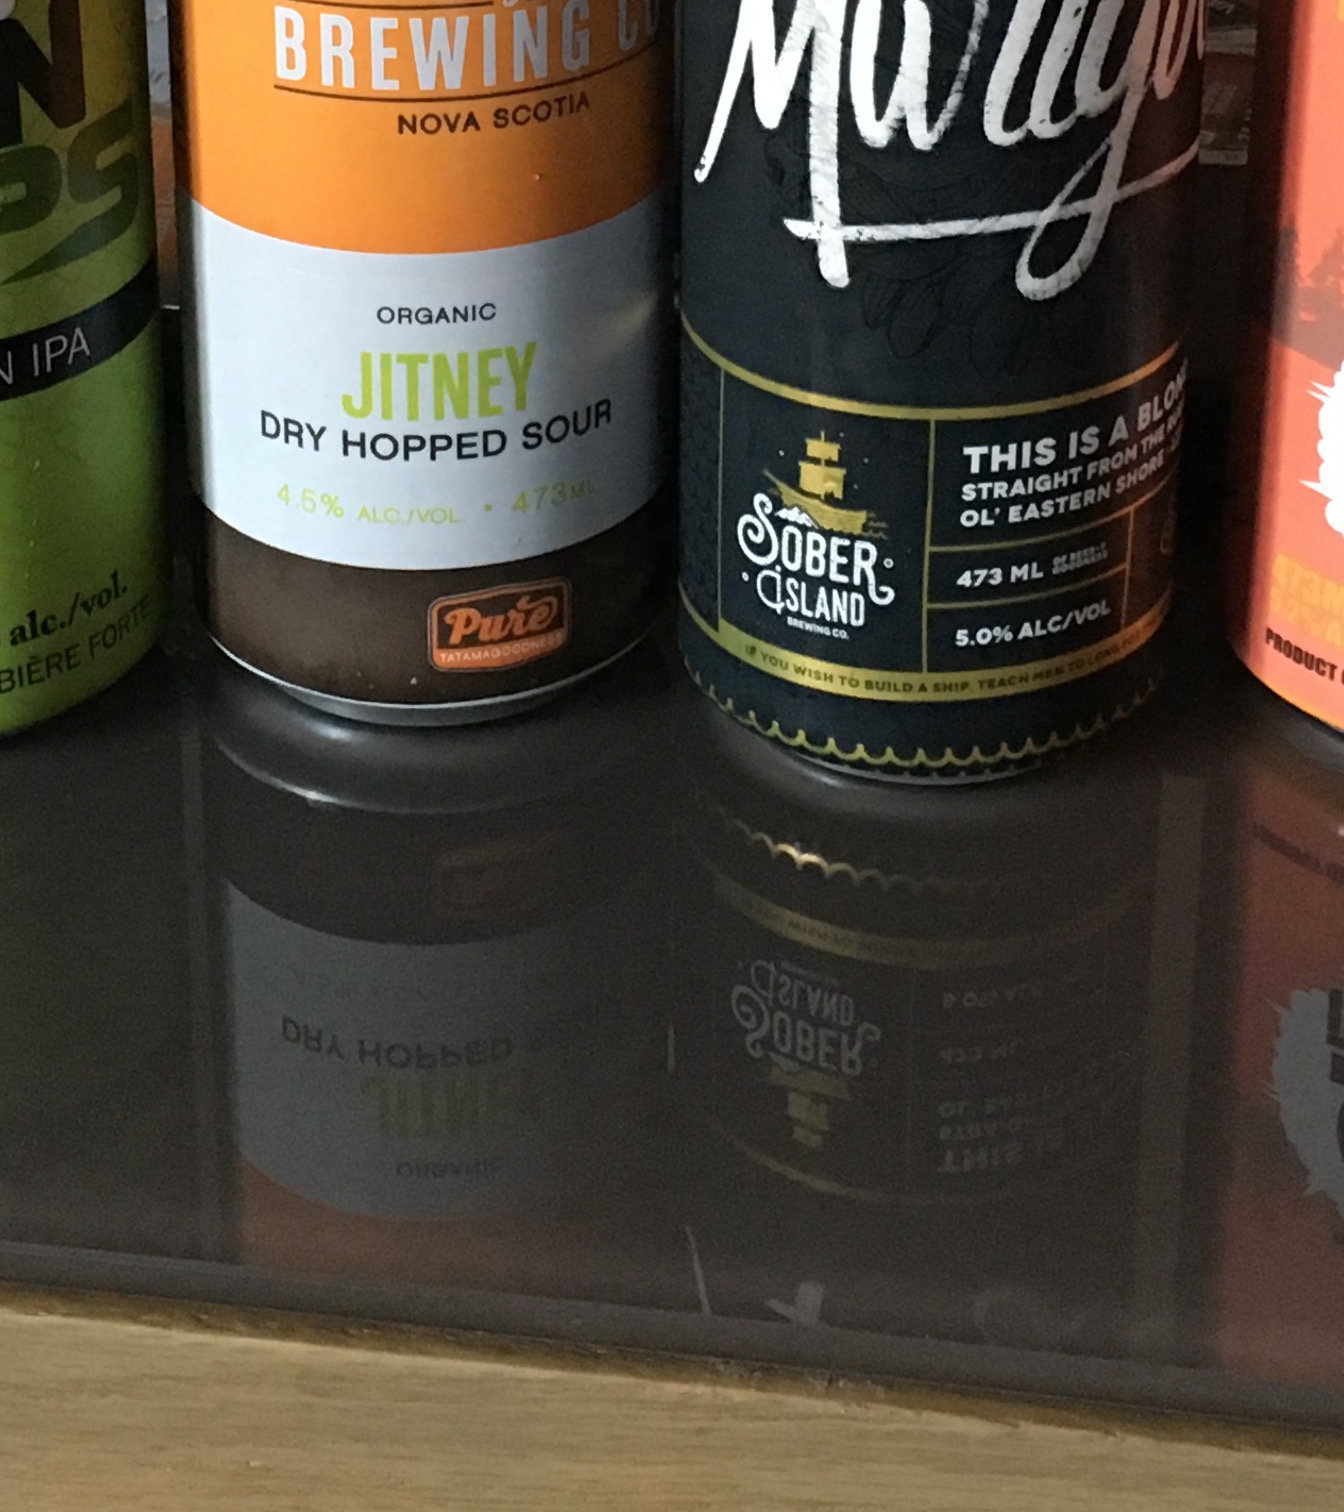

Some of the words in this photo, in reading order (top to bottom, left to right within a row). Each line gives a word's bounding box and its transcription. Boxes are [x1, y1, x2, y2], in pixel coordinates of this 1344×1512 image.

[397, 110, 481, 135] NOVA
[493, 91, 591, 129] SCOTIA
[376, 302, 498, 325] ORGANIC
[31, 326, 92, 376] IPA
[341, 341, 538, 420] JITNEY
[260, 410, 327, 452] DRY
[342, 428, 508, 461] HOPPED
[522, 399, 612, 451] SOUR
[962, 438, 1057, 474] THIS
[1068, 426, 1100, 459] IS
[1108, 414, 1129, 446] A
[961, 465, 1083, 501] STRAIGHT
[1086, 446, 1138, 481] FROM
[1141, 423, 1165, 454] THE
[1008, 481, 1111, 523] EASTERN
[1115, 448, 1164, 493] SHORE
[277, 484, 345, 518] 4.5%
[737, 492, 895, 605] SOBER
[957, 567, 1003, 588] 473
[1010, 562, 1044, 583] ML
[10, 570, 129, 648] alc./vol.
[444, 595, 558, 645] Pure
[756, 565, 866, 627] ISLAND
[955, 625, 1014, 647] 5.0%
[1017, 599, 1112, 640] ALC/VOL
[88, 595, 153, 657] FORTE
[787, 616, 831, 637] BREWING
[760, 651, 789, 670] YOU
[792, 663, 834, 684] WISH
[838, 675, 860, 688] TO
[864, 679, 913, 693] BUILD
[917, 682, 928, 693] A
[977, 673, 1029, 690] TEACH
[1032, 666, 1065, 682] MEN
[1265, 627, 1338, 681] PRODUCT
